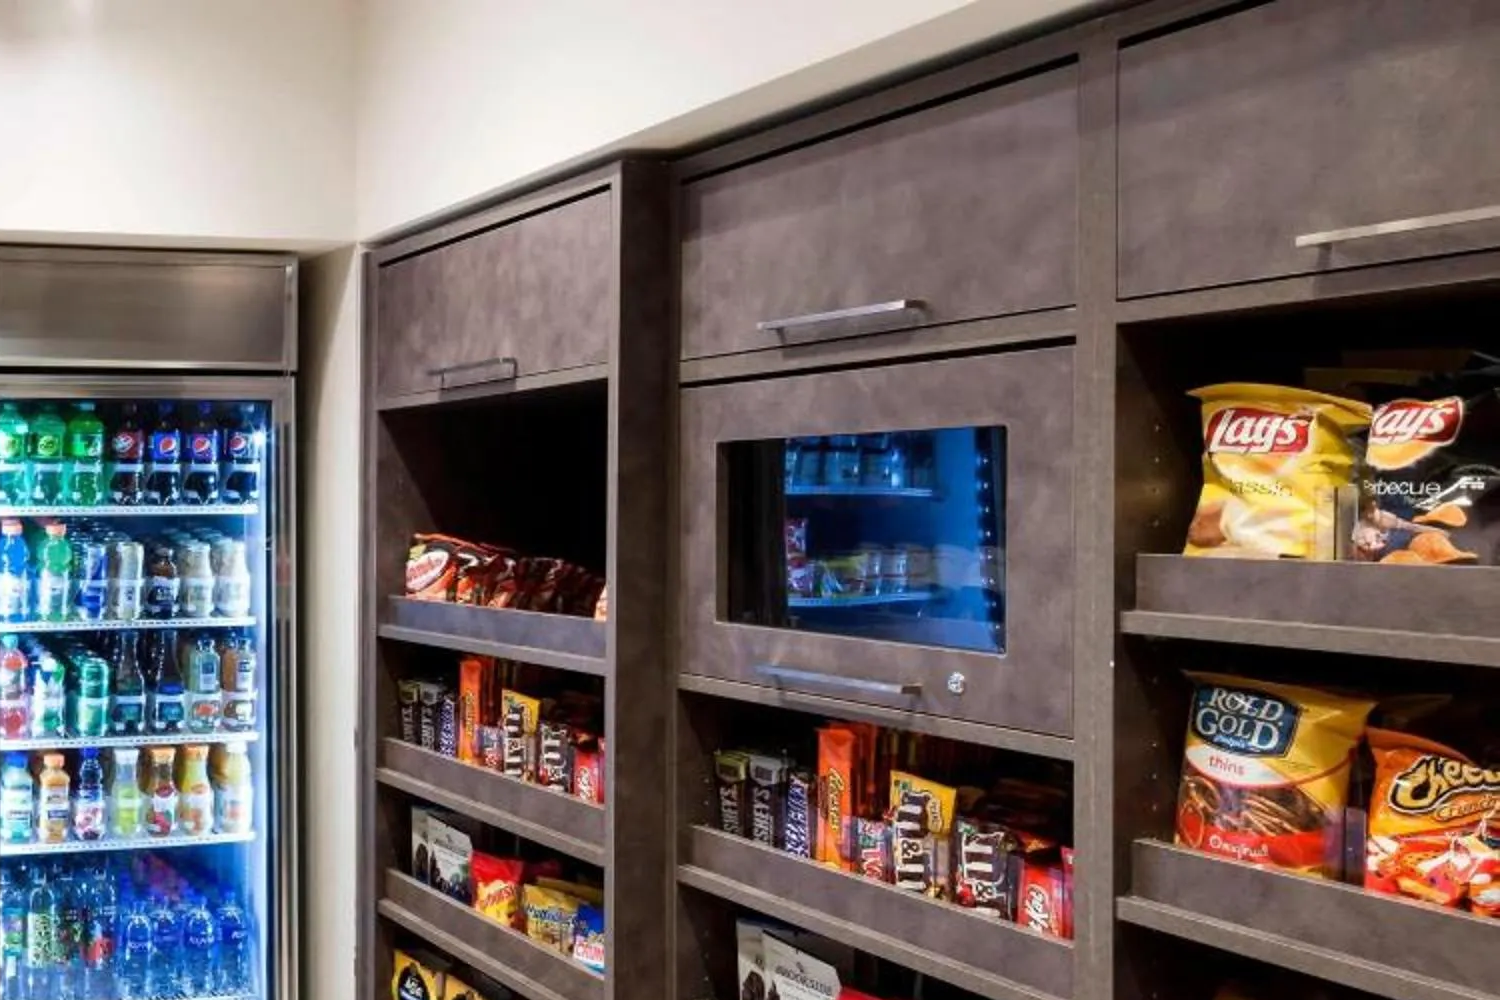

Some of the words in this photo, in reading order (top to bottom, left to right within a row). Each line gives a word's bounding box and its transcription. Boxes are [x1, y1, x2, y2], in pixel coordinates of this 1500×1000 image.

[1209, 687, 1285, 722] ROLD
[1195, 708, 1279, 750] GOLD
[1209, 754, 1246, 776] thins
